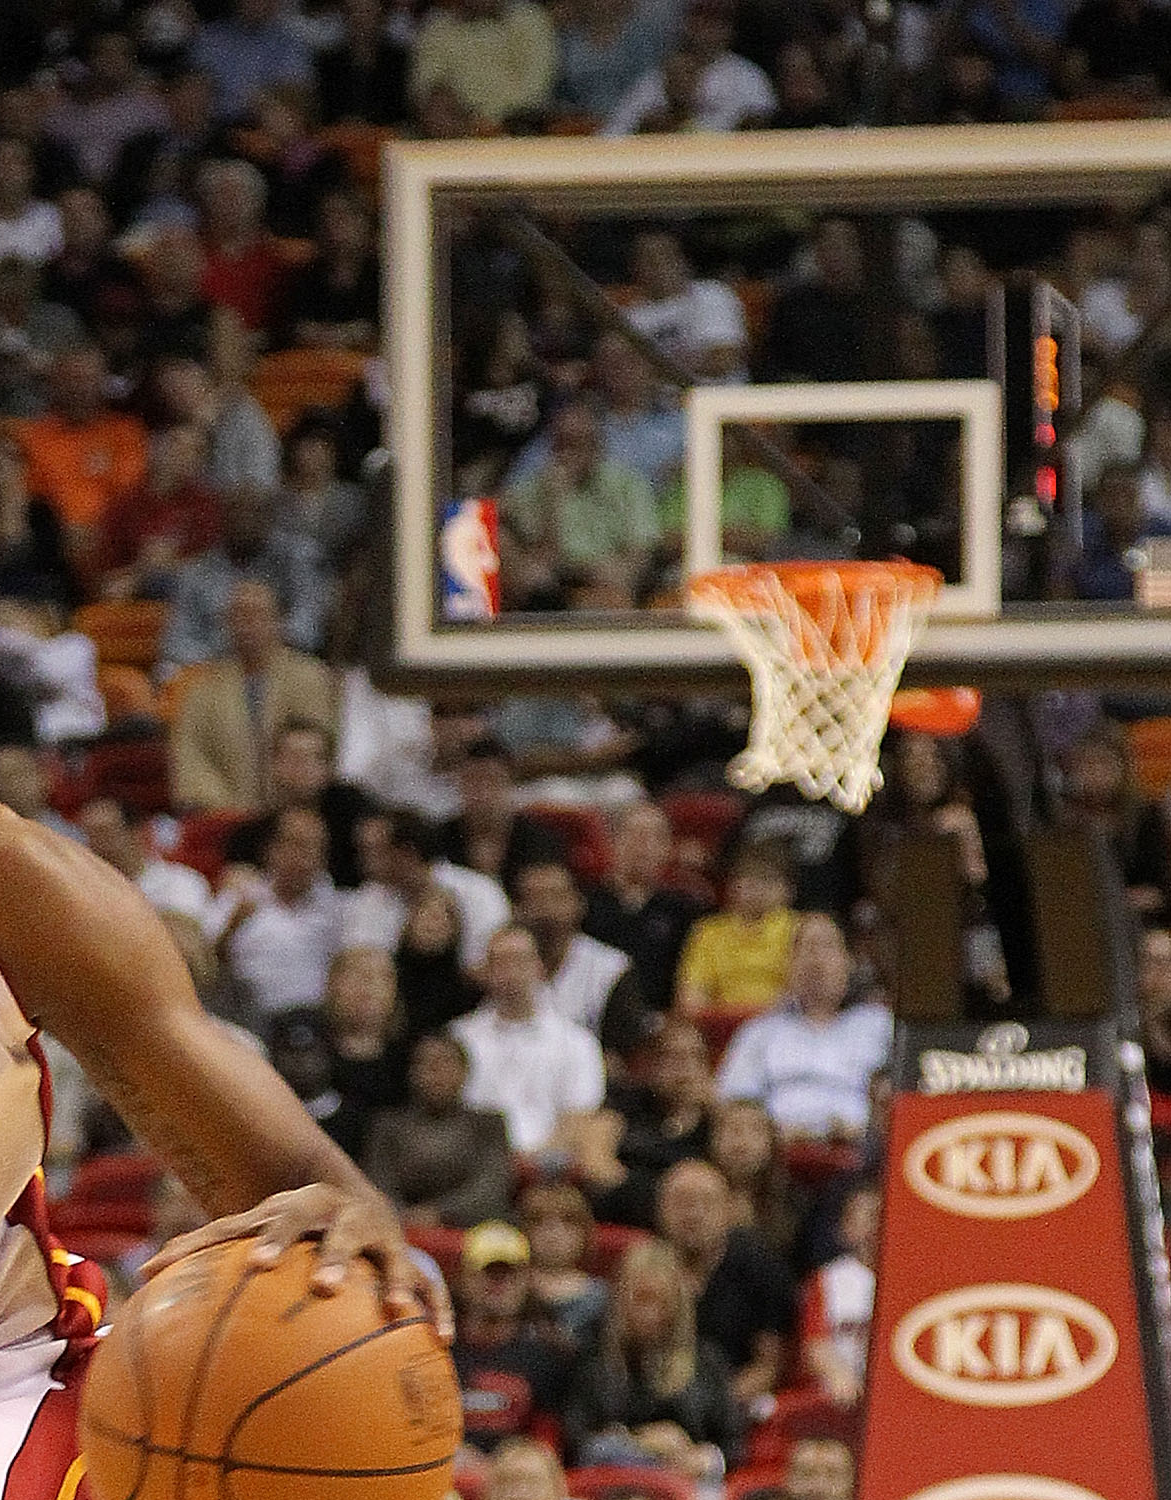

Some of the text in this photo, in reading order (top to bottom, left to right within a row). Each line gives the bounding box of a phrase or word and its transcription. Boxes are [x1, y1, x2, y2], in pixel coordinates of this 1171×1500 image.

[919, 1046, 1087, 1096] SPALDING
[940, 1136, 1074, 1195] KIA
[932, 1311, 1086, 1376] KIA
